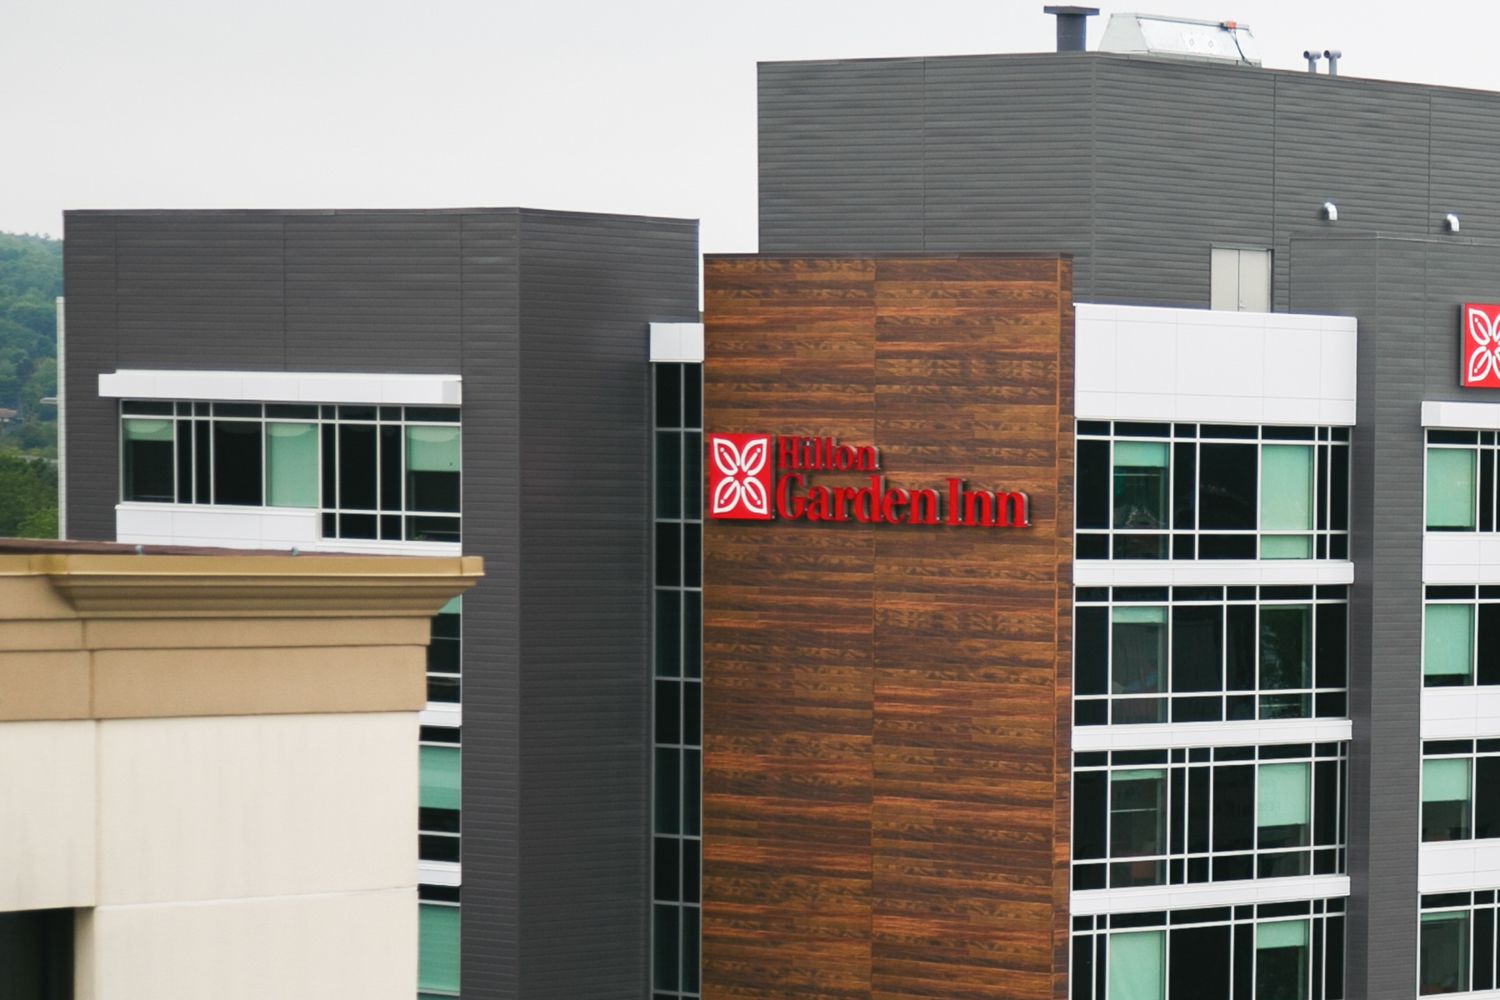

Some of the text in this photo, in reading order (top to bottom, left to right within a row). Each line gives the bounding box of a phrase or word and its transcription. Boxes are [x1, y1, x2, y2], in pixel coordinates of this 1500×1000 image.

[776, 435, 880, 472] Hilton
[775, 473, 1032, 528] Garden Inn
